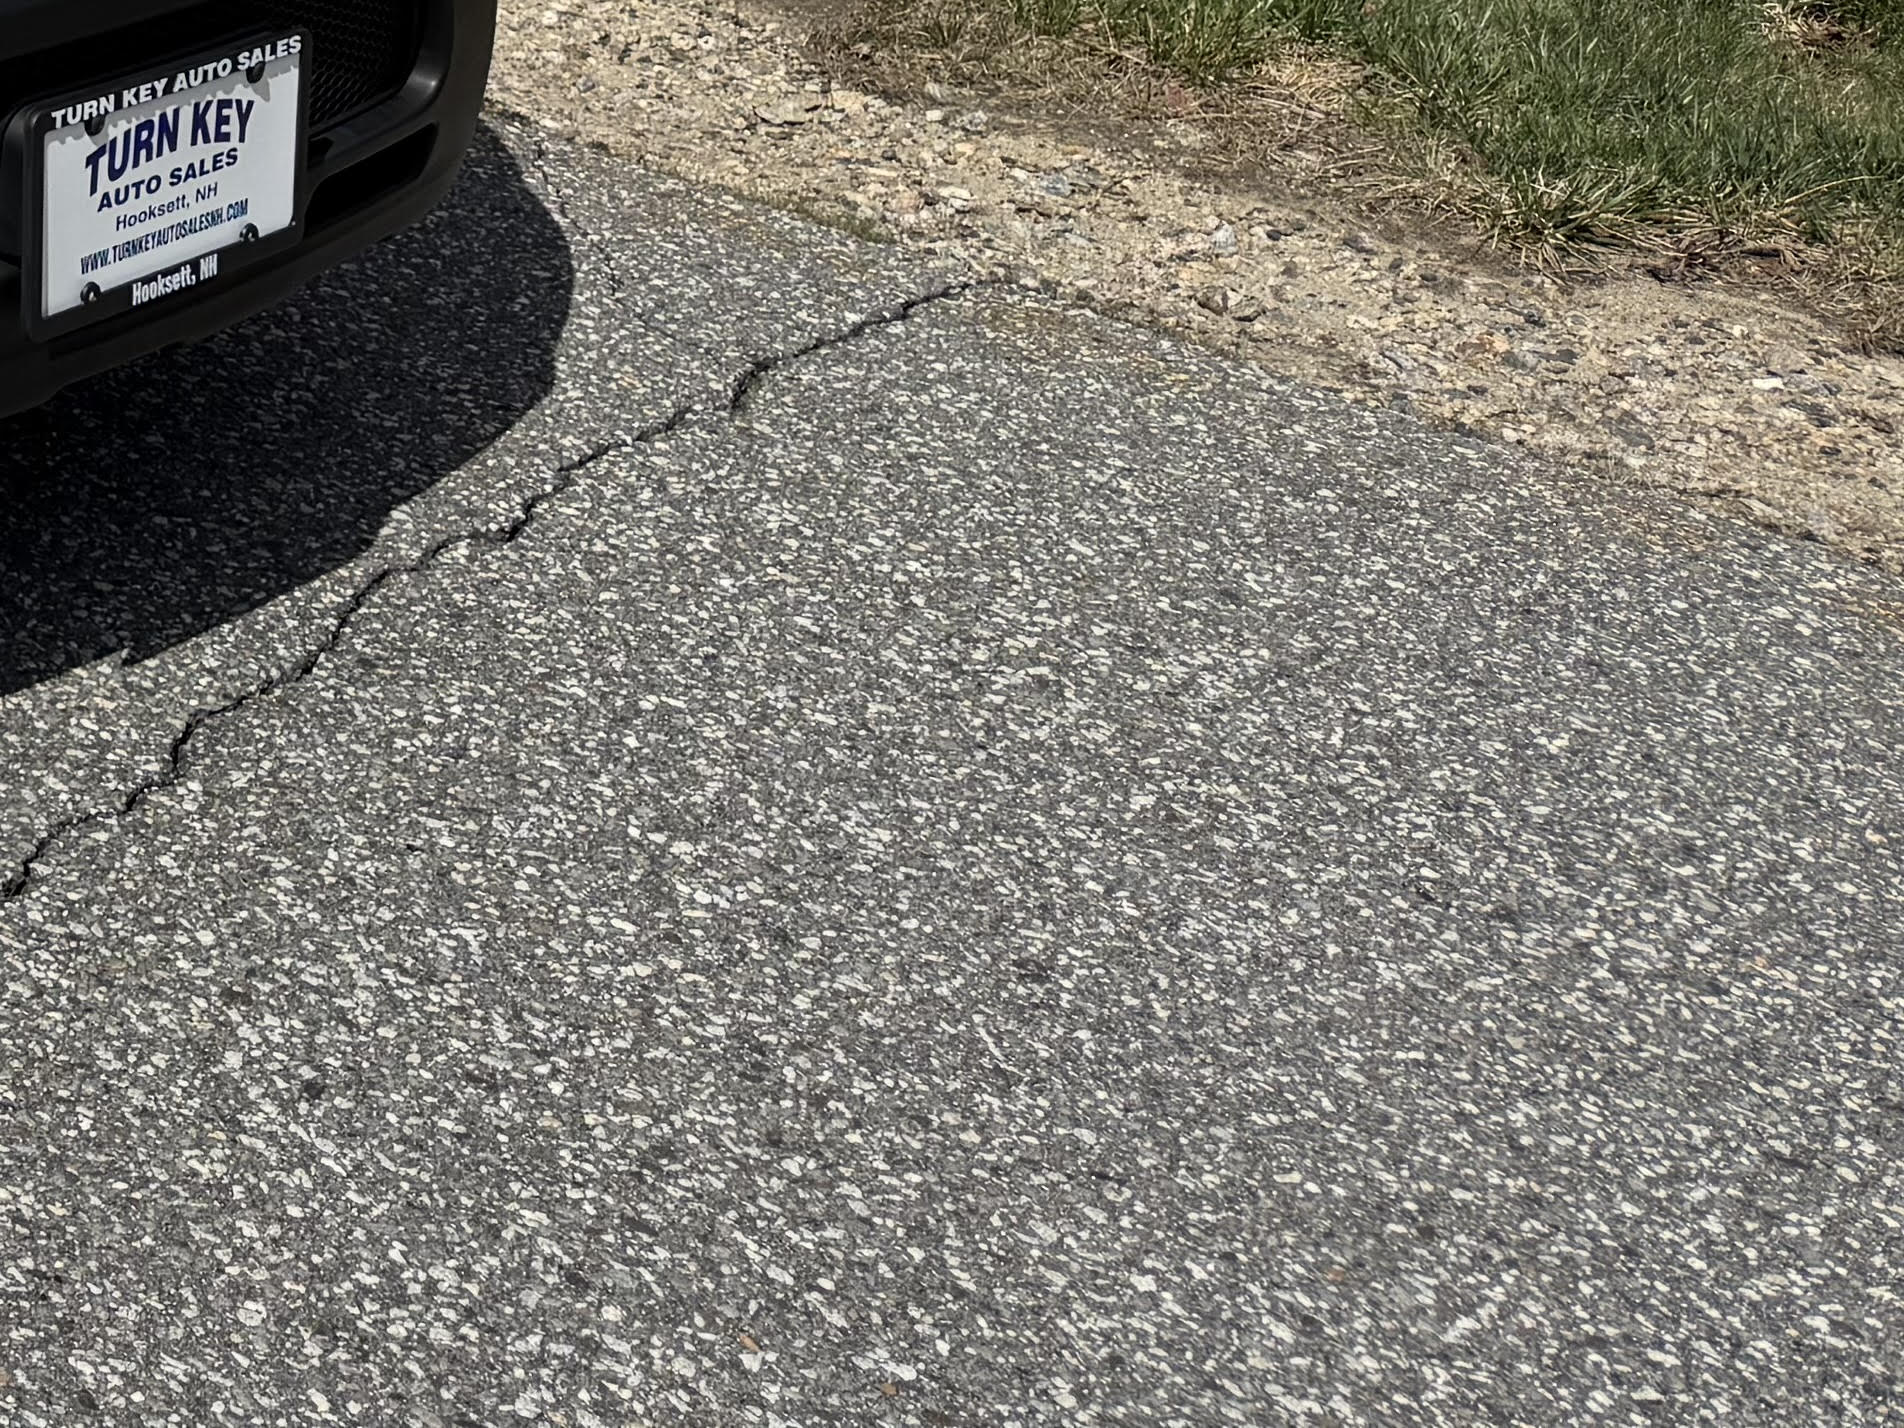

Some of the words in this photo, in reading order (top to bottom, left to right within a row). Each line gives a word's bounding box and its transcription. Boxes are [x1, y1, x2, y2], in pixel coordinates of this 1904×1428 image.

[51, 94, 115, 129] TURN
[122, 77, 169, 109] KEY
[172, 58, 233, 93] AUTO
[237, 35, 302, 71] SALES
[85, 107, 181, 197] TURN
[190, 98, 255, 146] KEY
[97, 175, 162, 213] AUTO
[169, 147, 239, 187] SALES
[80, 197, 249, 276] WWW.TURNKEYAUTOSALESNH.COM
[116, 194, 190, 232] Hooksett,
[195, 181, 218, 204] NH
[131, 263, 196, 307] Hooksett,
[199, 253, 218, 281] NH
